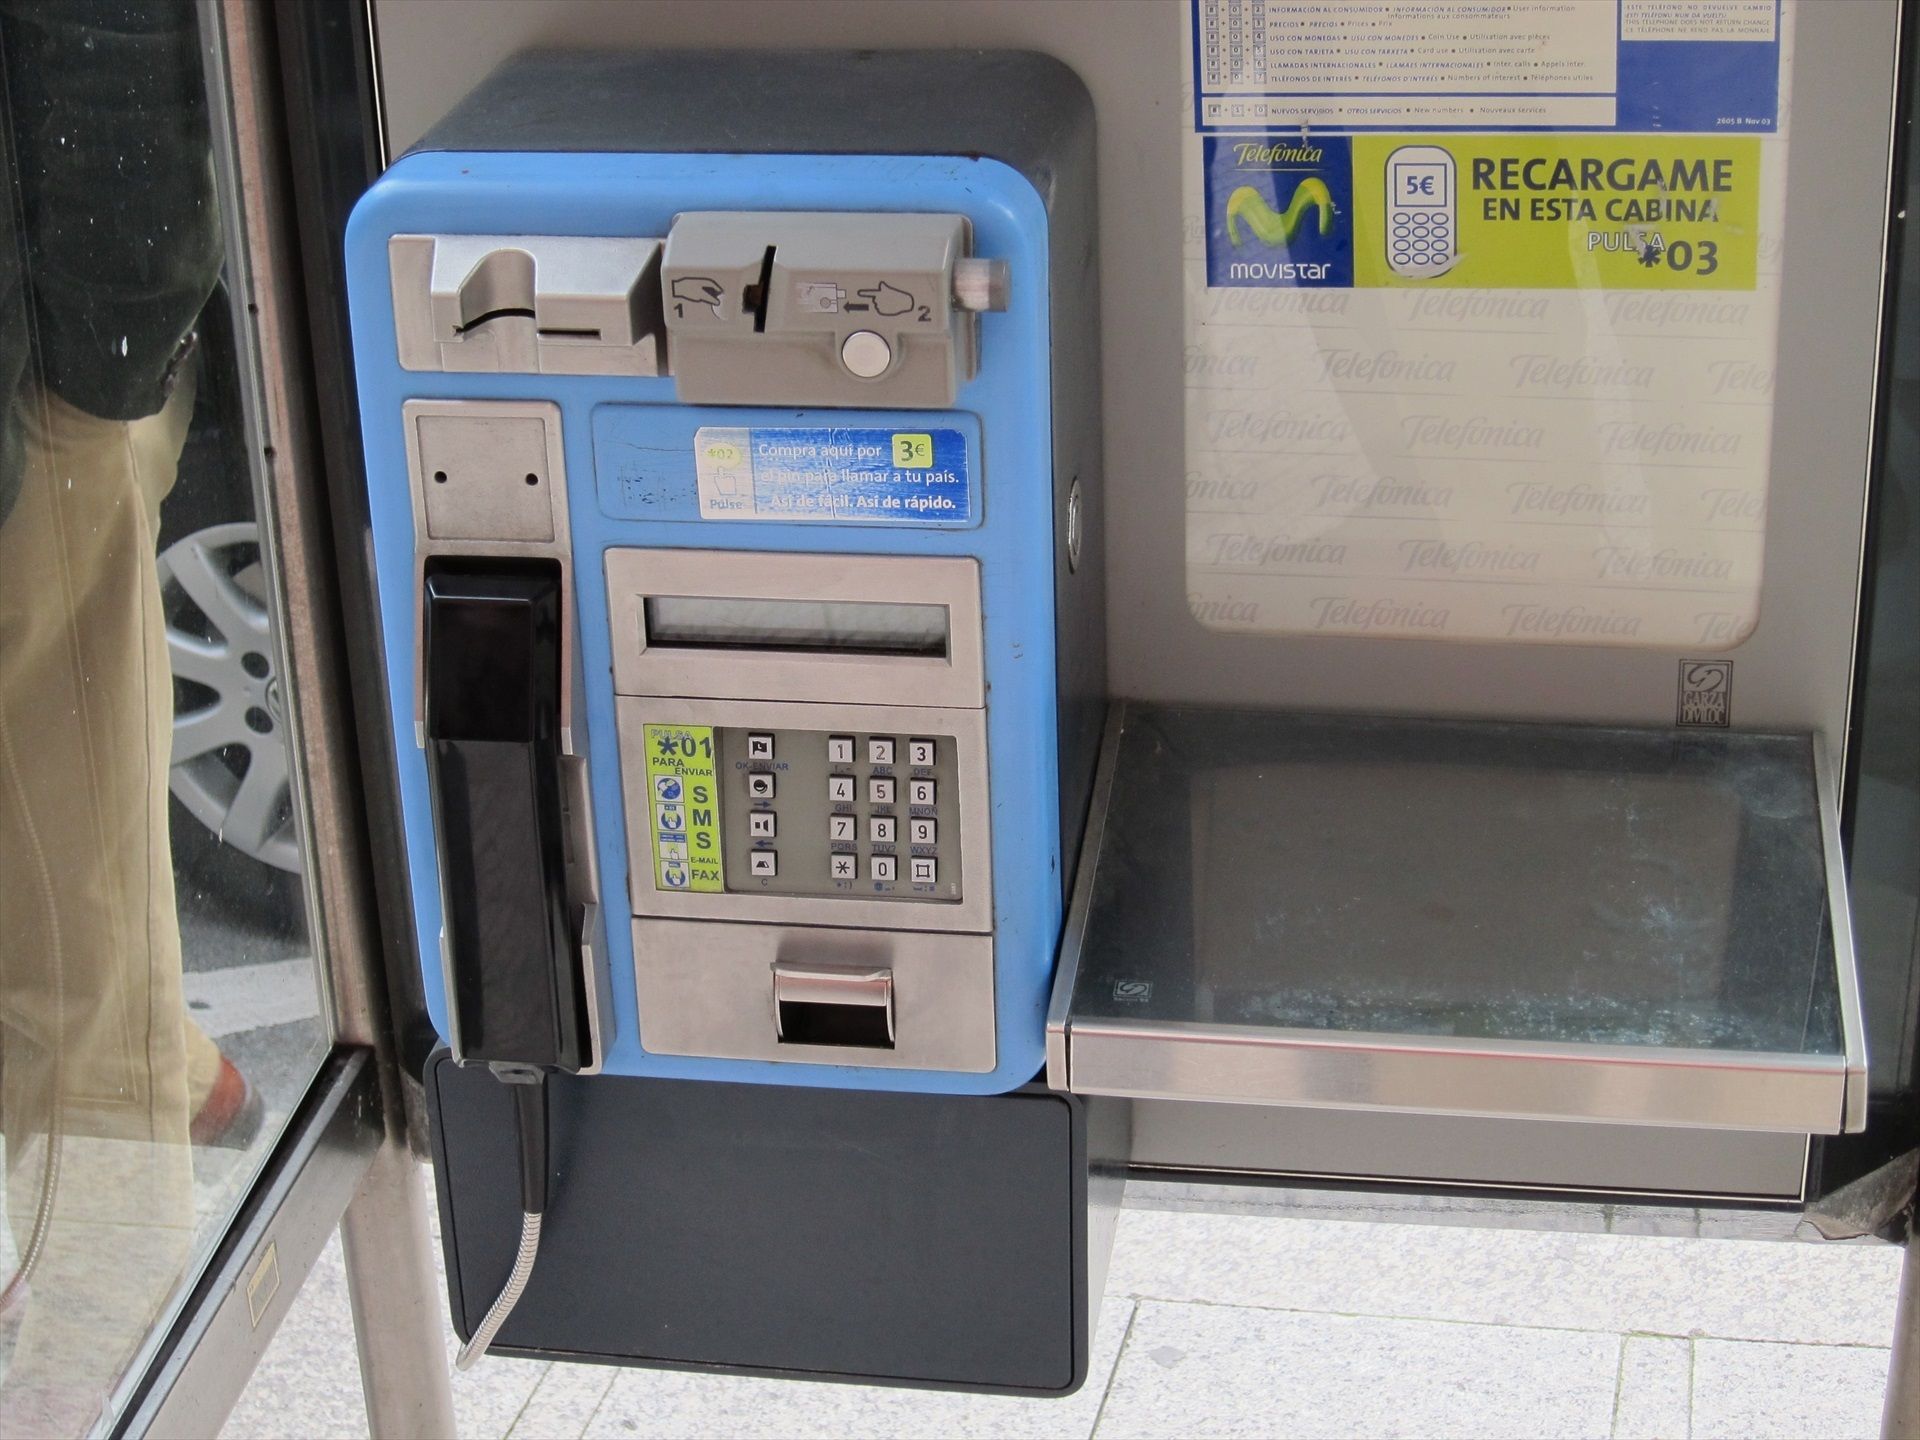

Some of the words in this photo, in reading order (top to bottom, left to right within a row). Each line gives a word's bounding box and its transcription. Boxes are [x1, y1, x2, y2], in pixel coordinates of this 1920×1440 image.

[1472, 158, 1733, 192] RECARGAME
[1406, 175, 1435, 196] 5€
[1483, 198, 1520, 222] EN
[1530, 198, 1598, 222] ESTA
[1605, 198, 1719, 222] CABINA
[673, 302, 684, 319] 1
[917, 305, 932, 322] 2
[759, 443, 816, 460] Compra
[857, 446, 882, 461] por
[893, 474, 901, 483] a
[905, 470, 920, 483] tu
[926, 469, 960, 487] país.
[710, 499, 743, 510] Pulse
[799, 495, 815, 508] de
[882, 496, 900, 508] de
[905, 495, 956, 512] rápido.
[653, 757, 684, 767] PARA
[876, 745, 886, 761] 2
[916, 747, 926, 762] 3
[674, 768, 713, 777] ENVIAR
[872, 766, 893, 775] ABC
[836, 783, 845, 798] 4
[876, 784, 886, 799] 5
[917, 786, 927, 800] 6
[837, 821, 847, 837] 7
[877, 823, 887, 838] 8
[918, 824, 928, 839] 9
[690, 856, 719, 865] E-MAIL
[878, 862, 888, 876] 0
[692, 870, 720, 881] FAX
[761, 878, 768, 887] C
